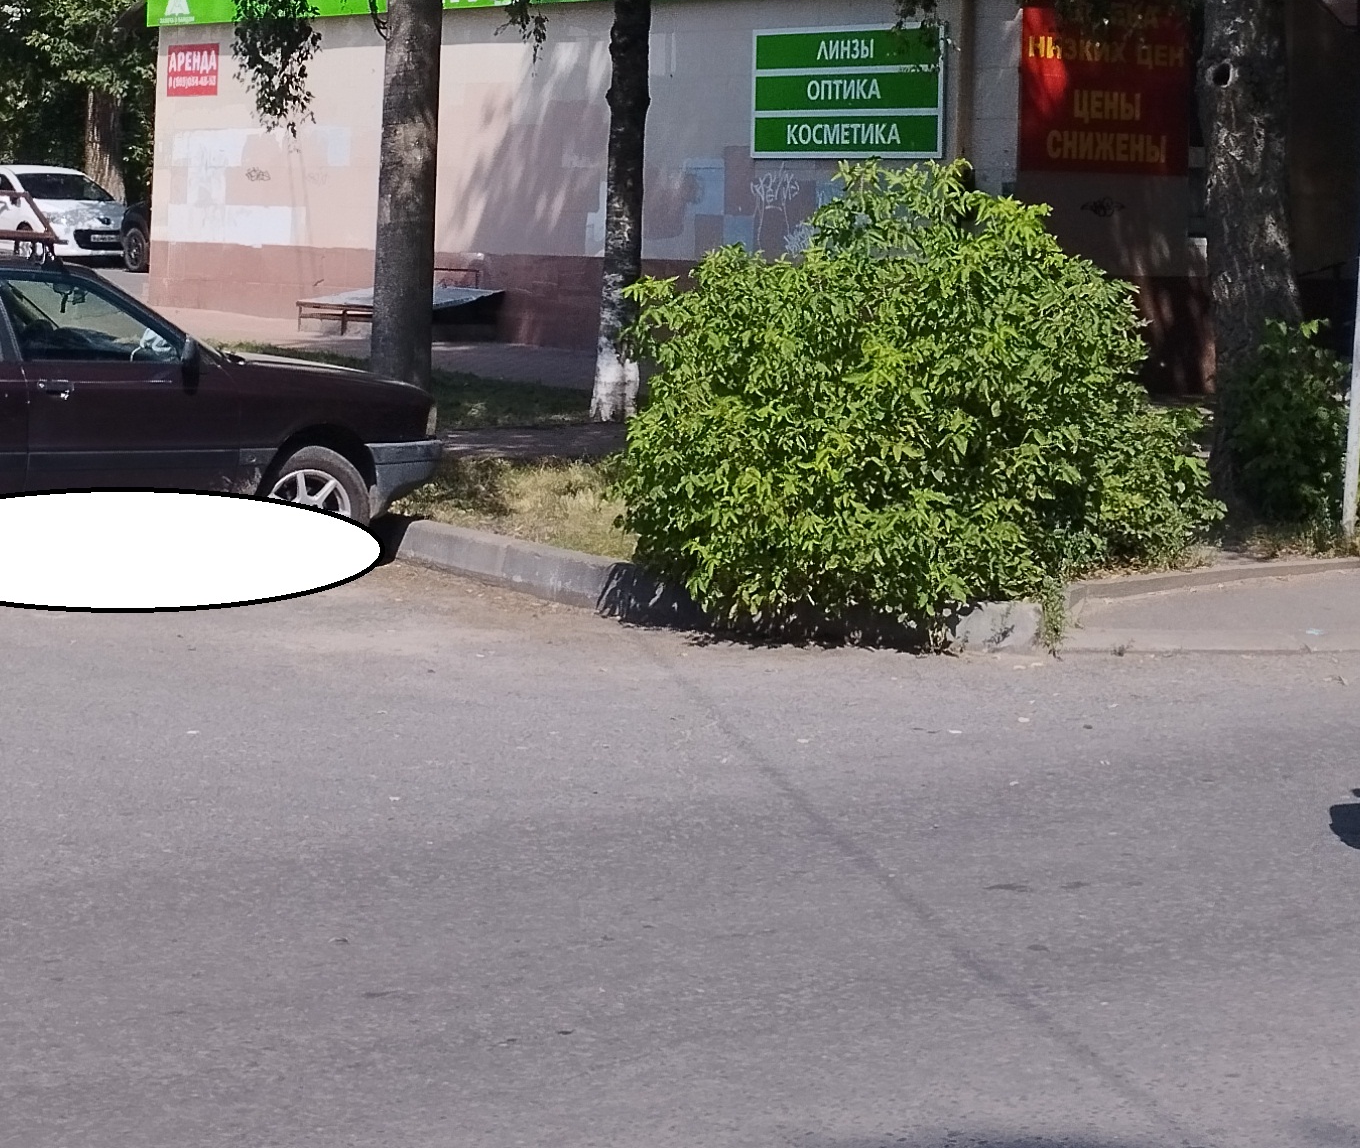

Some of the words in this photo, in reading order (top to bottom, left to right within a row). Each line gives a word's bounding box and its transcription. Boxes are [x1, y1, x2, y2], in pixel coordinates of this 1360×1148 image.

[168, 49, 217, 74] АРЕНДА
[816, 38, 874, 61] ЛИНЗЫ
[1136, 43, 1185, 70] ЦЕН
[807, 78, 882, 101] ОПТИКА
[1073, 88, 1142, 125] ЦЕНЫ
[786, 123, 901, 145] КОСМЕТИКА
[1045, 129, 1168, 164] СНИЖЕНЫ
